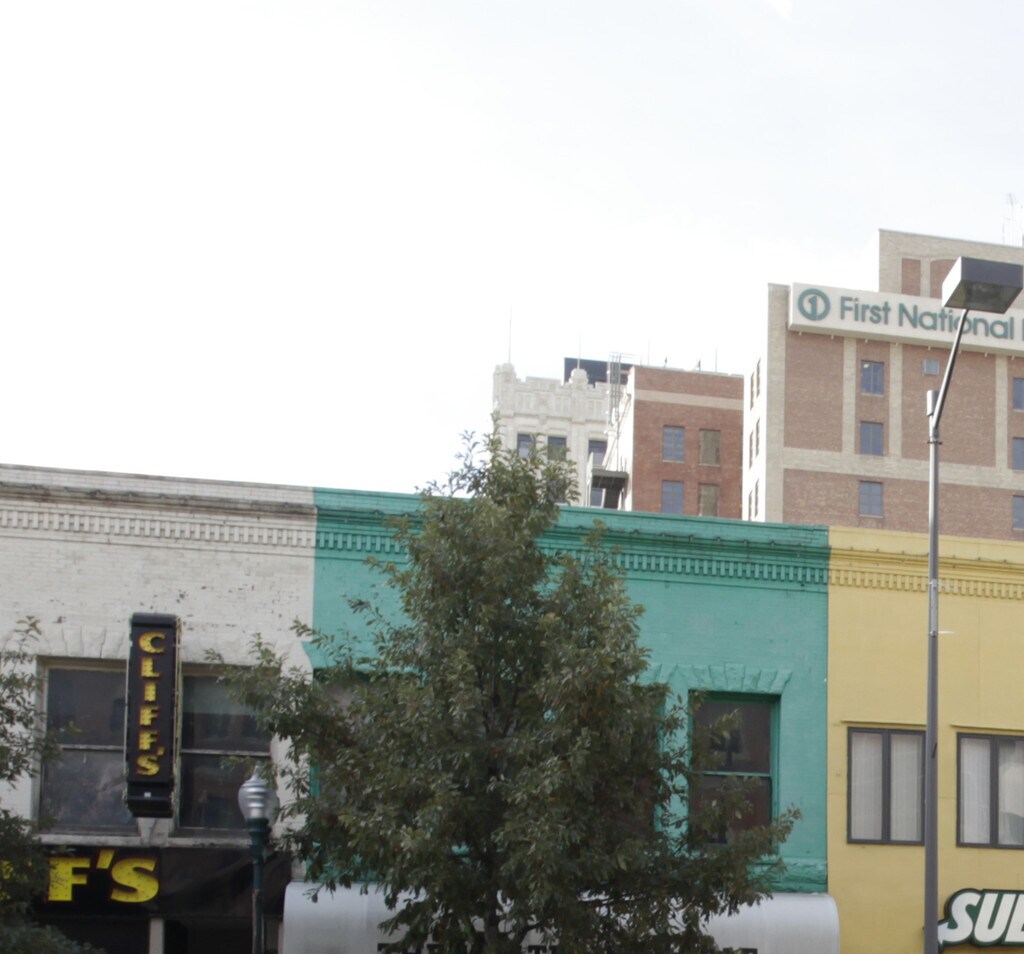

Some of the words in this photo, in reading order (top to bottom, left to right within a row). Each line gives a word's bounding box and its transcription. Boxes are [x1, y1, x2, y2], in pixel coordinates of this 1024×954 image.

[839, 296, 891, 325] First
[898, 303, 1014, 340] National
[137, 631, 165, 776] CLIFF'S
